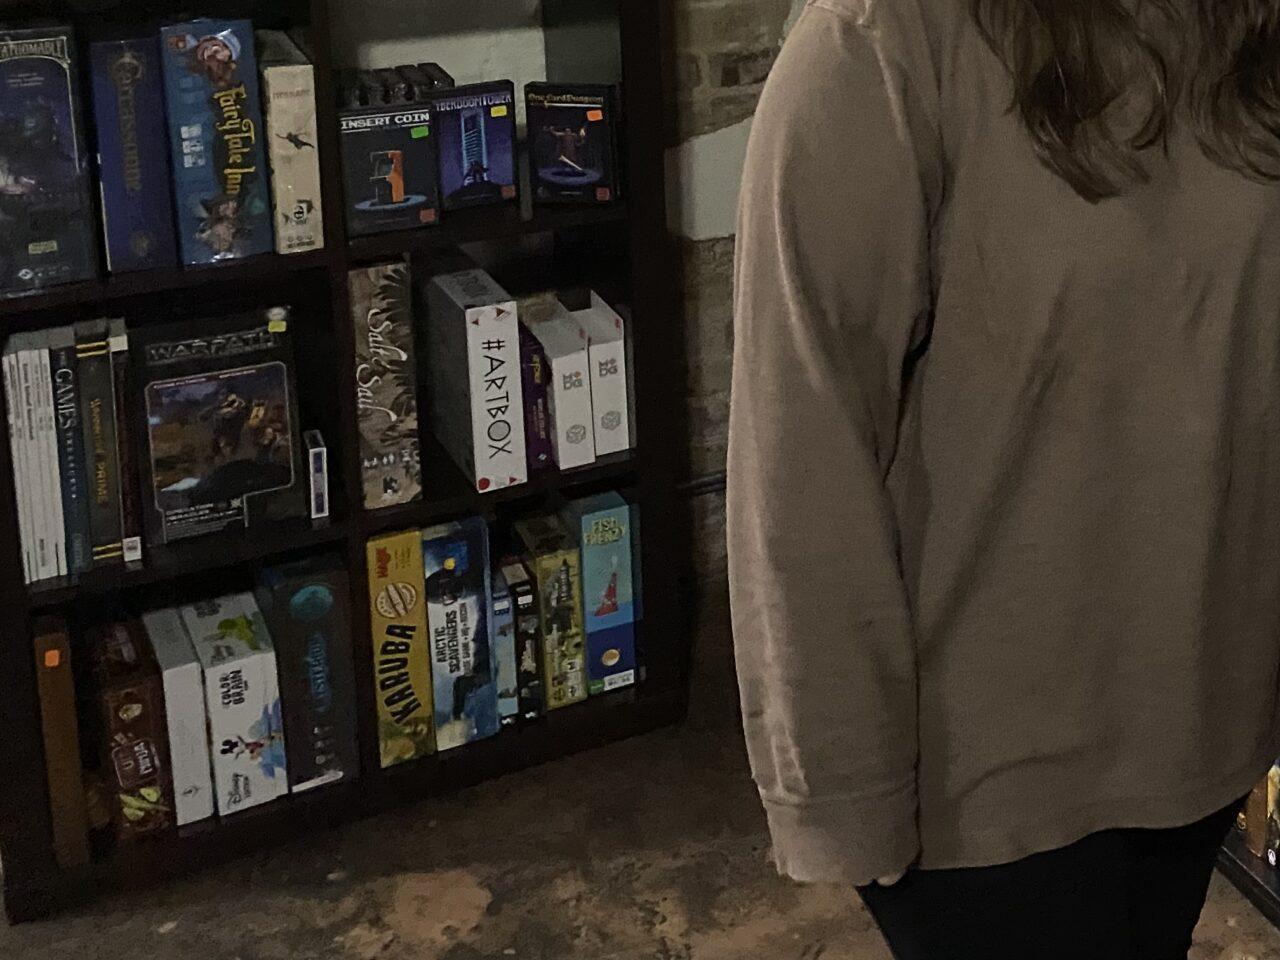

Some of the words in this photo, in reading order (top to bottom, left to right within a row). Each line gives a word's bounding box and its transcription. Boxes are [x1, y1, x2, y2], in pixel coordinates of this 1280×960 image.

[212, 85, 247, 131] Fairy
[341, 117, 390, 130] INSERT
[394, 112, 430, 124] COIN
[224, 119, 256, 164] Tale
[224, 165, 256, 194] Inn
[368, 308, 408, 362] Salt
[54, 368, 77, 430] GAMES
[356, 364, 398, 422] Sail
[481, 338, 513, 460] #ARTBOX
[434, 626, 447, 664] ARCTIC
[448, 610, 458, 674] SCAVENGERS
[379, 623, 421, 725] KARUBA
